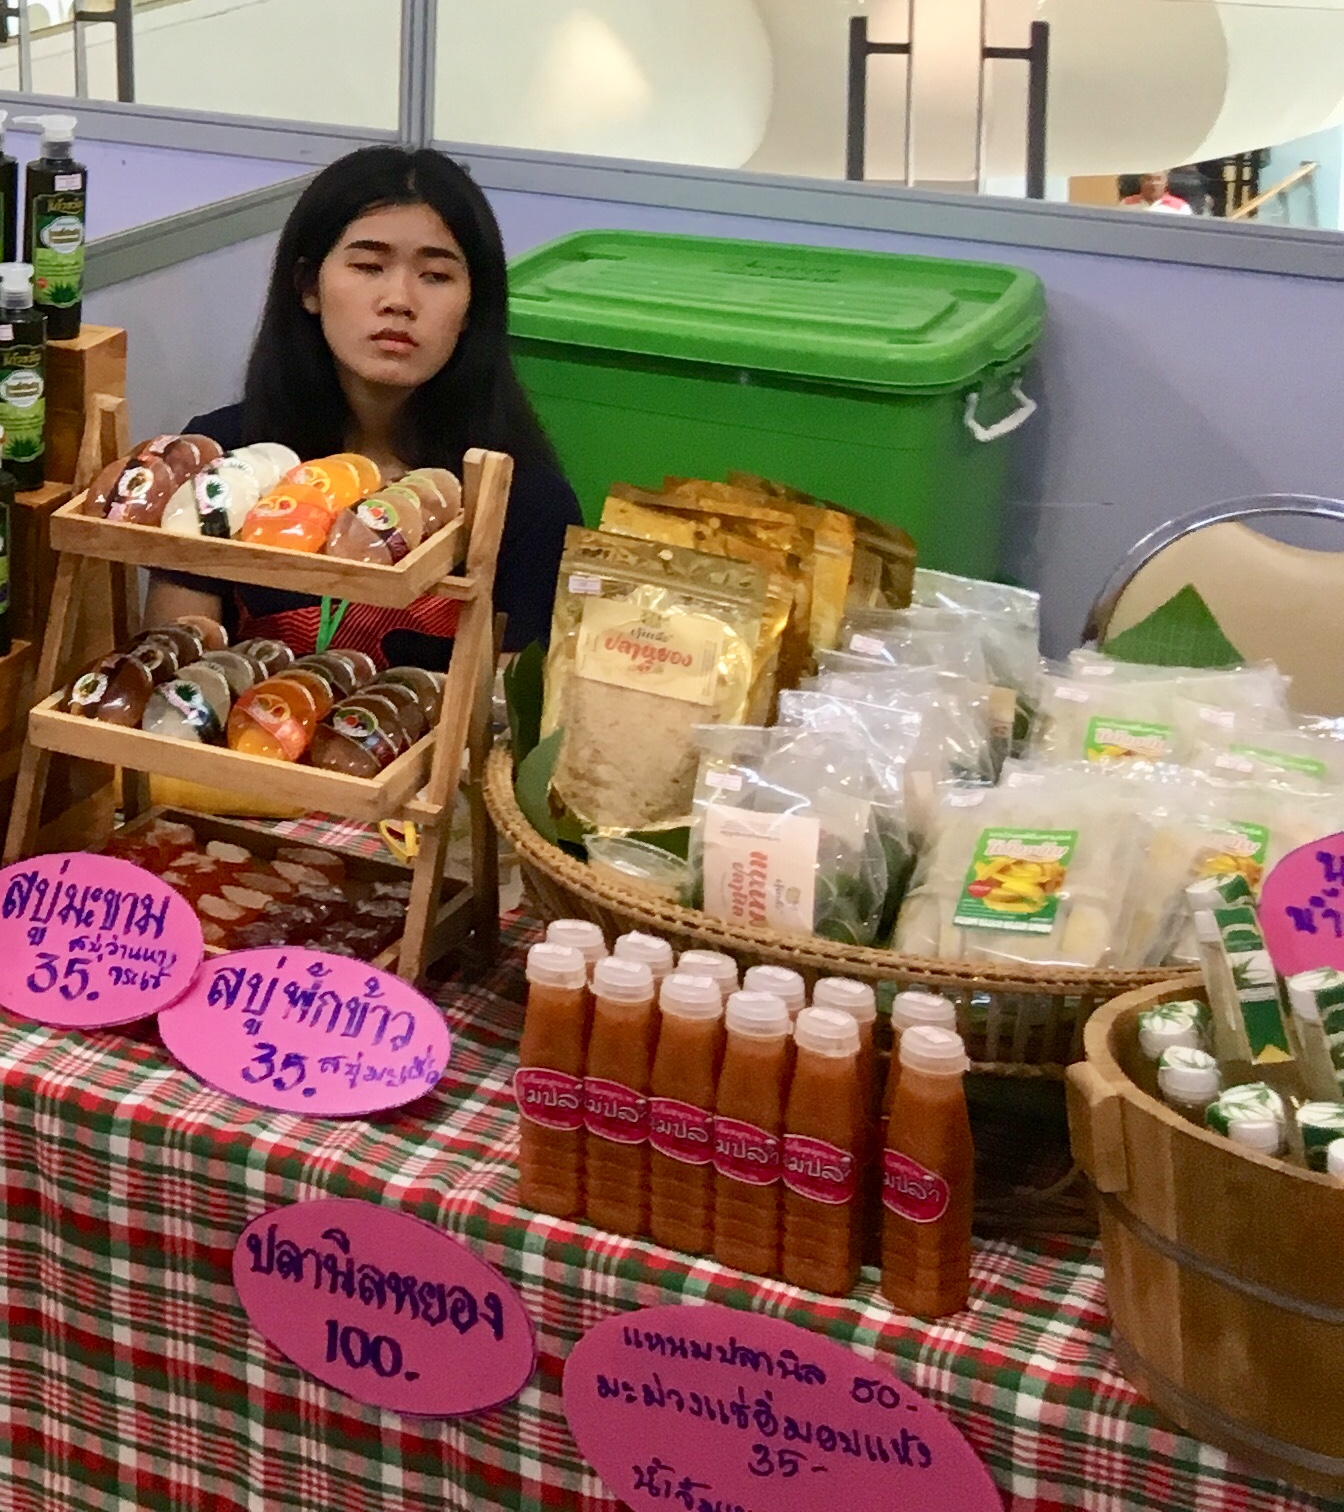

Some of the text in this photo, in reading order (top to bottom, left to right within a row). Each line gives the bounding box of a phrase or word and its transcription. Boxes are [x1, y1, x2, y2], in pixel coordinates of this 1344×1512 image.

[2, 858, 171, 948] สบู่มะขาม
[246, 1223, 505, 1341] ปลานิลหยอง
